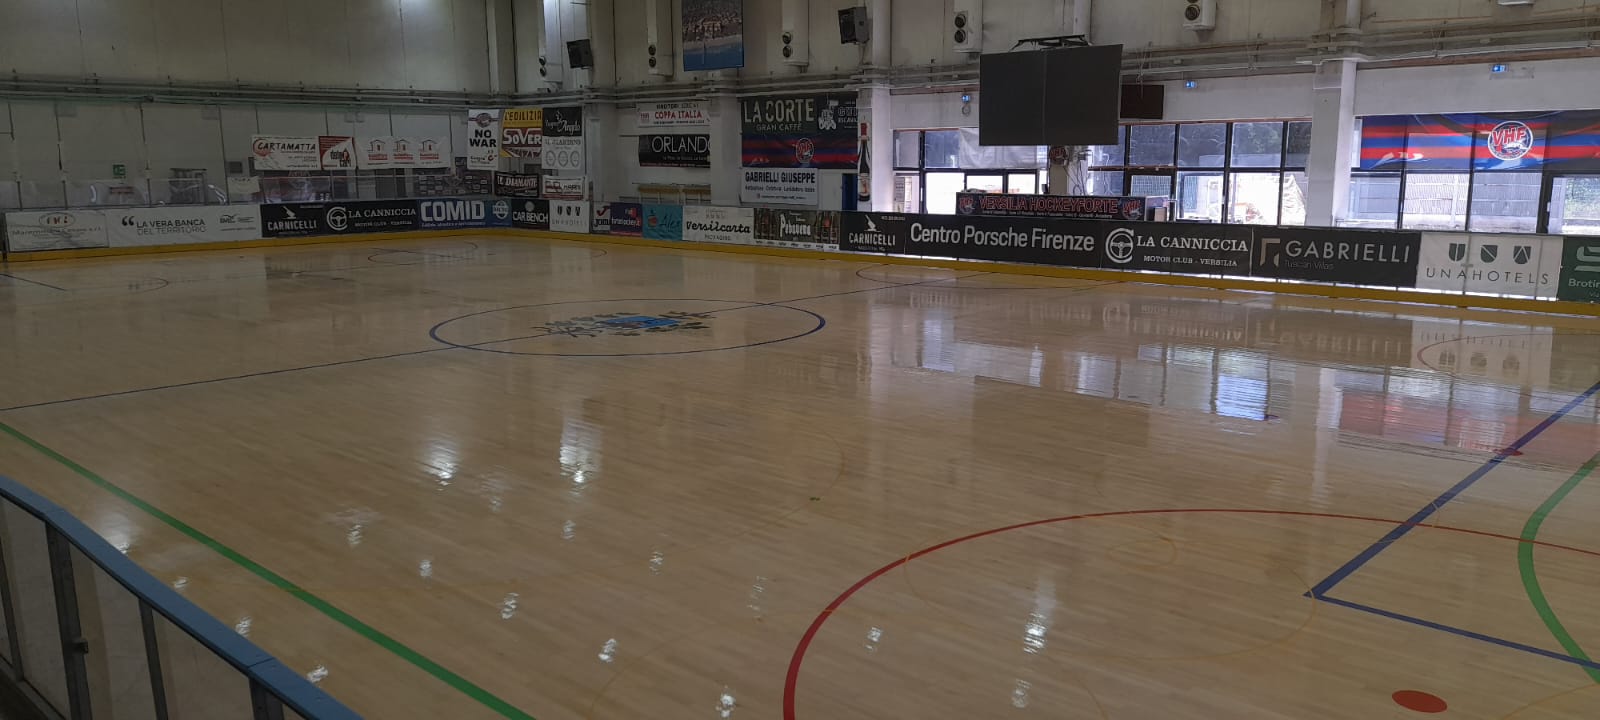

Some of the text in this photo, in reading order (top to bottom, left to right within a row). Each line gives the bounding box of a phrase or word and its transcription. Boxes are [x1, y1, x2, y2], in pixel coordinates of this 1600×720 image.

[654, 111, 676, 119] COPPA
[678, 110, 702, 119] ITALIA
[743, 100, 762, 123] LA
[765, 98, 815, 123] CORTE
[475, 129, 492, 138] NO
[756, 123, 777, 131] GRAN
[1492, 125, 1527, 146] VHF
[257, 142, 316, 150] CARTAMATTA
[469, 138, 497, 148] WAR
[651, 136, 710, 153] ORLAND
[497, 175, 504, 185] IL
[745, 171, 816, 184] GABRIELLI GIUSEPPE
[978, 196, 1027, 211] VERSILIA
[348, 208, 416, 218] LA CANNICCIA
[420, 200, 485, 222] COMID
[149, 220, 174, 228] VERA
[175, 219, 206, 227] BANCA
[267, 219, 317, 231] CARNICELLI
[686, 220, 751, 234] Versilcarta
[137, 226, 207, 236] DEL TERRITORIO
[910, 222, 1095, 252] Centro Porsche Firenze
[848, 232, 896, 246] CARNICELLI
[1136, 235, 1249, 252] LA CANNICCIA
[1285, 240, 1410, 263] GABRIELLI
[1143, 255, 1171, 263] MOTOR
[1200, 258, 1238, 267] VERSILIA
[1426, 267, 1549, 285] UNAHOTELS
